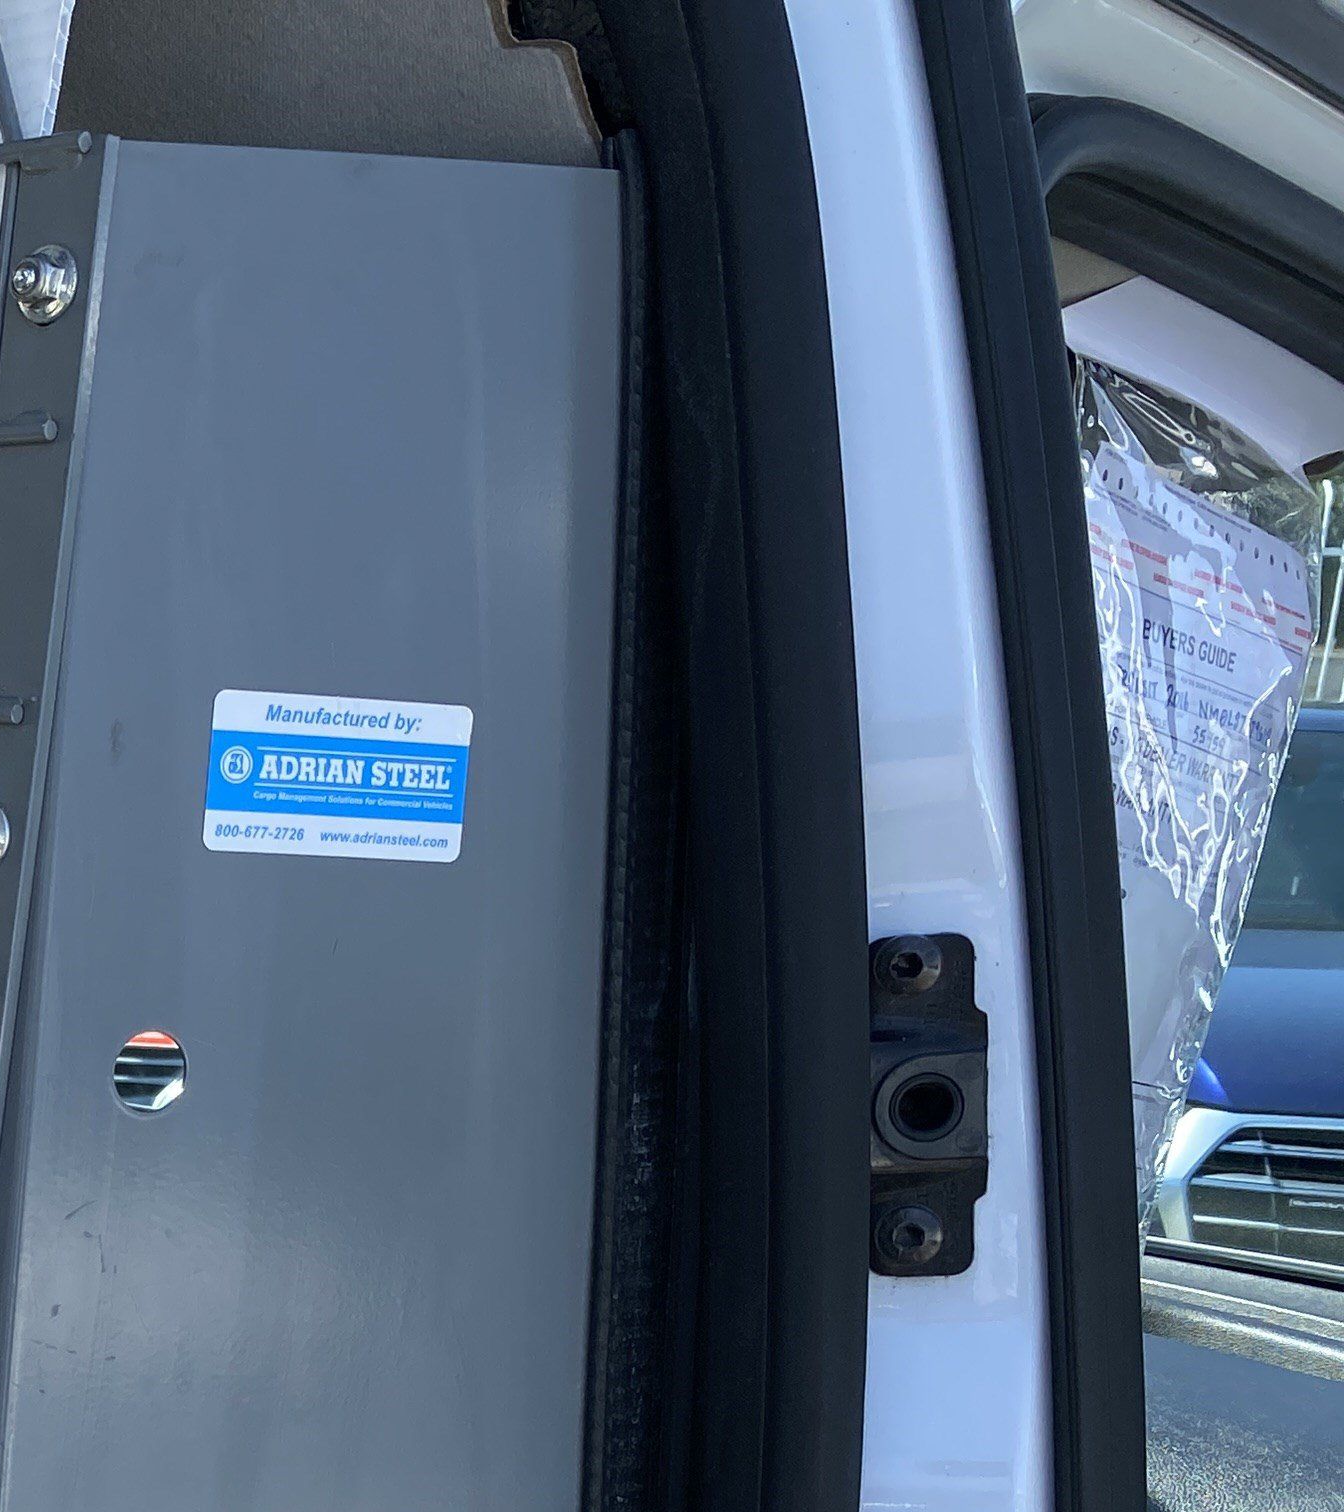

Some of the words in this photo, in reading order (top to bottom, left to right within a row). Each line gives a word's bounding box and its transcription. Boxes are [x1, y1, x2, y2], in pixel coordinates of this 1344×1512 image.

[1143, 618, 1196, 656] BUYERS
[1198, 641, 1237, 673] GUIDE
[265, 703, 391, 729] Manufactured
[394, 713, 423, 735] by:
[259, 754, 365, 785] ADRIAN
[371, 760, 451, 790] STEEL
[328, 794, 363, 805] Solutions
[214, 823, 305, 842] 800-677-2726
[320, 829, 449, 849] www.adriansteel.com
